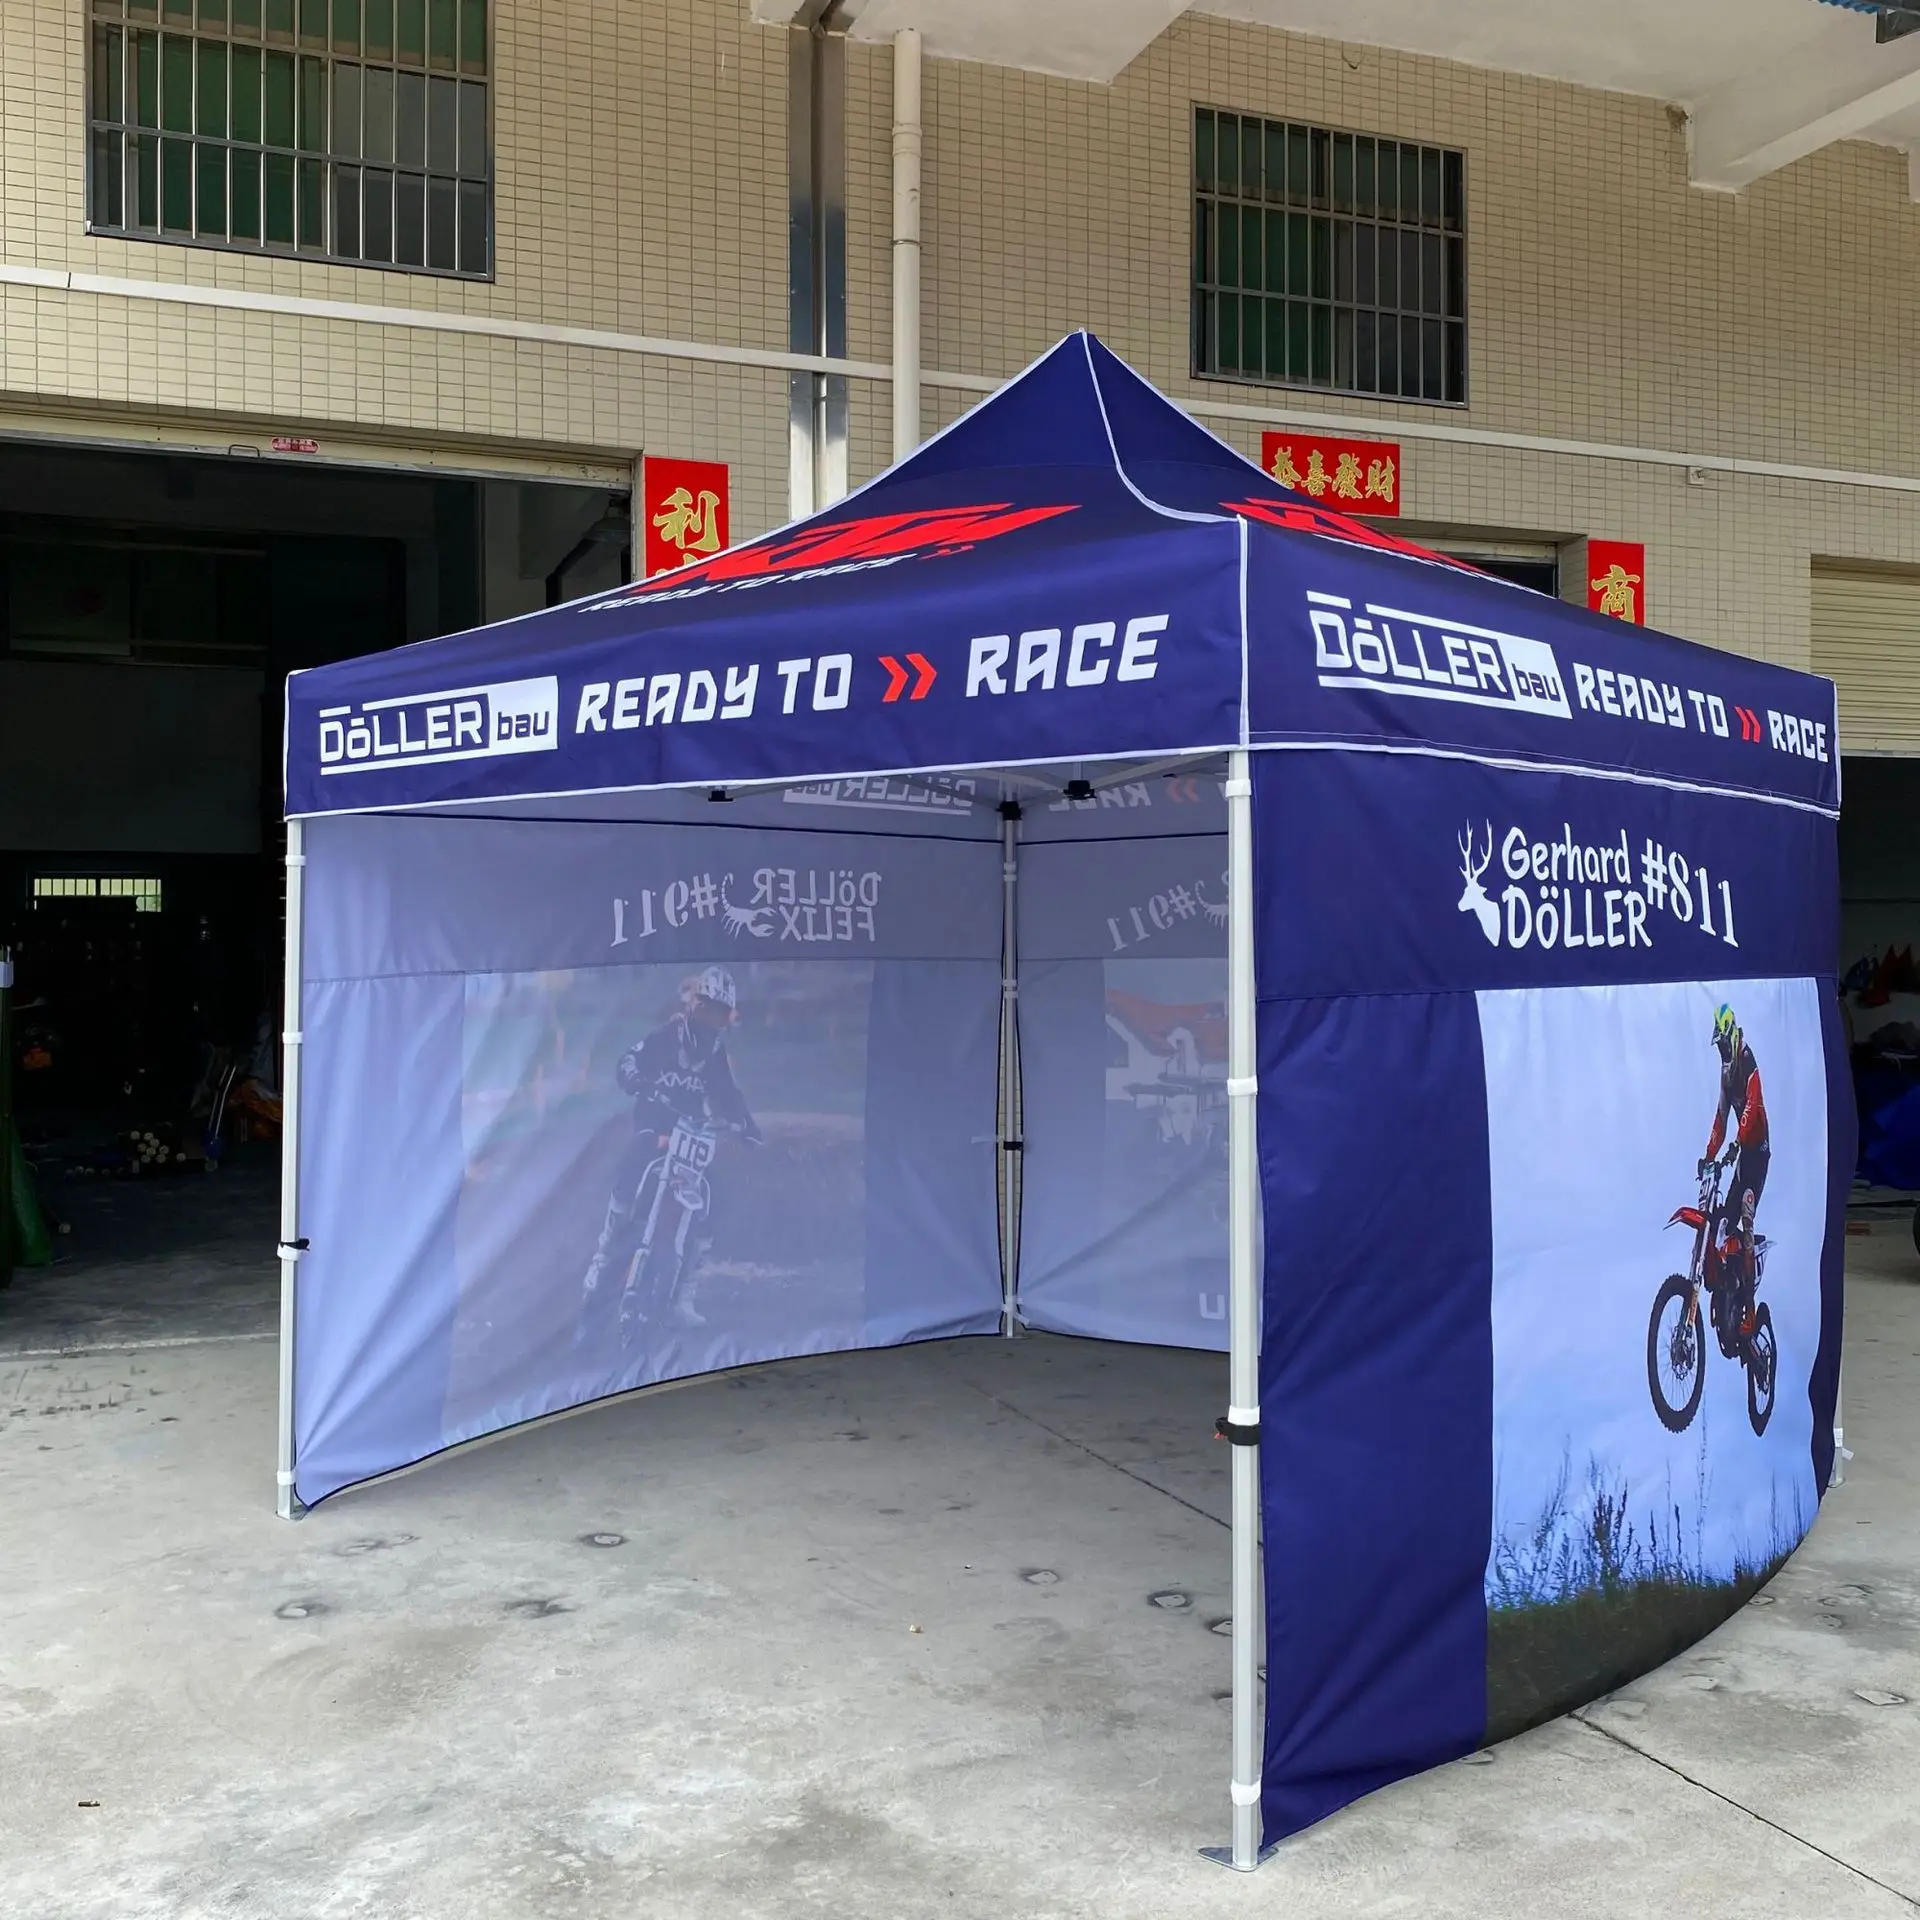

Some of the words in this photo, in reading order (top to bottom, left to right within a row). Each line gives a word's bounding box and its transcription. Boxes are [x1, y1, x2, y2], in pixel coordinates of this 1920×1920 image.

[652, 487, 720, 576] 利
[576, 664, 760, 733] READY
[777, 653, 852, 714] TO
[966, 614, 1169, 697] RACE
[1512, 663, 1561, 702] bau
[1573, 662, 1686, 728] READY
[1688, 690, 1729, 738] TO
[1767, 710, 1829, 763] RACE
[497, 711, 550, 741] bau
[1502, 822, 1631, 884] Gerhard
[1641, 838, 1738, 948] #811
